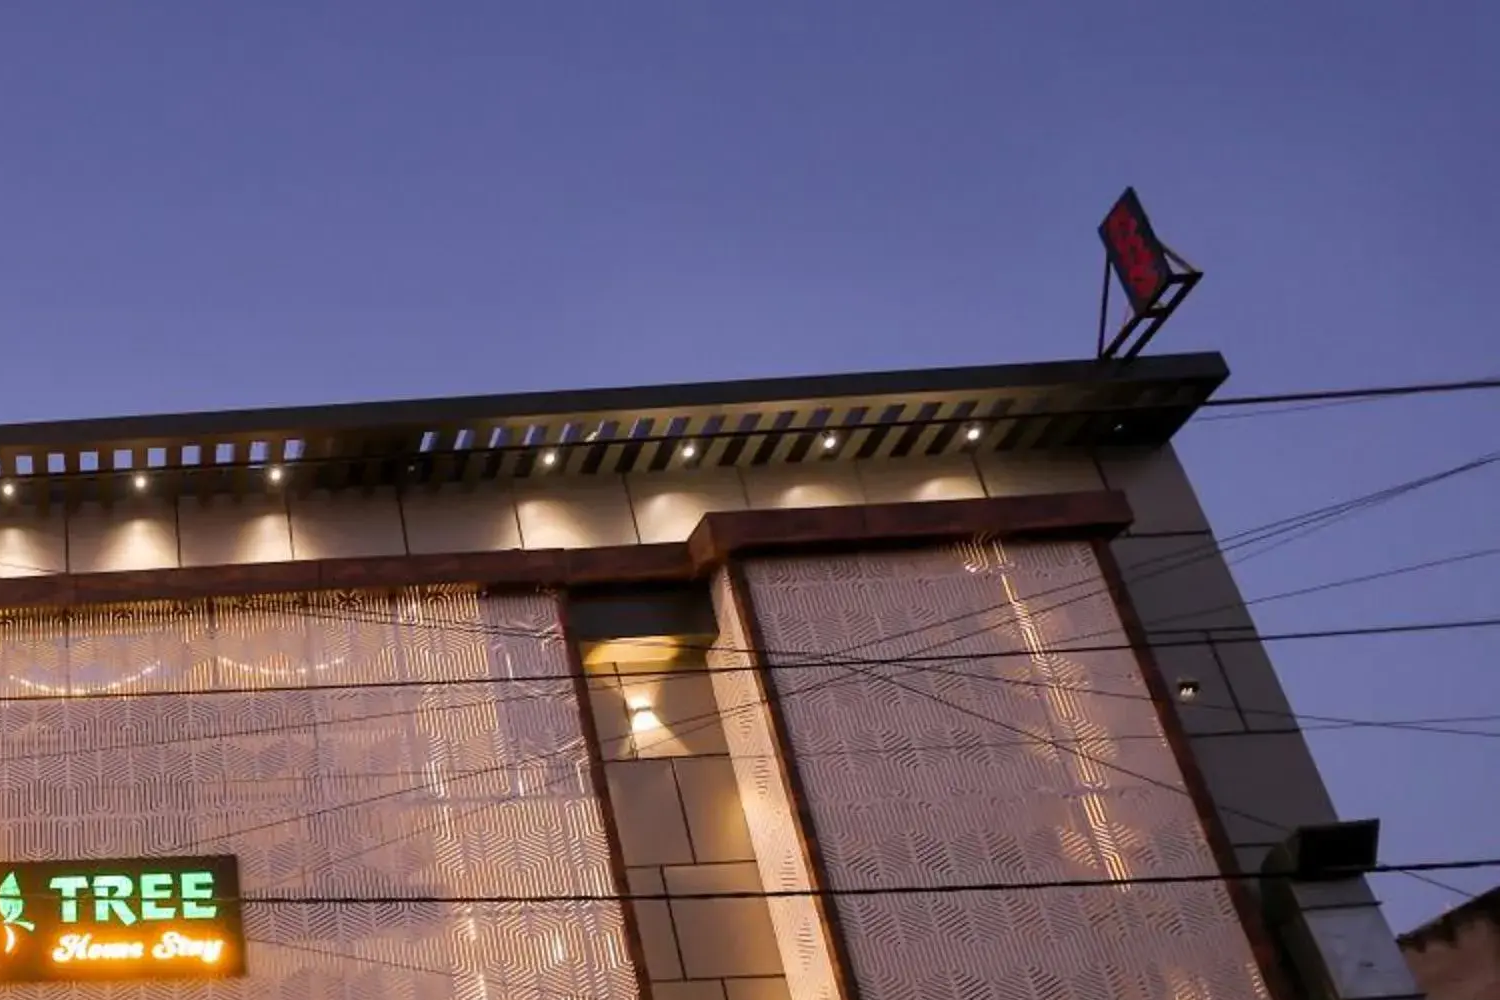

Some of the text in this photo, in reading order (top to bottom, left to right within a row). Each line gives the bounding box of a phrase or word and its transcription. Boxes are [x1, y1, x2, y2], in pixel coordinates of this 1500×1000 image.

[50, 872, 217, 926] TREE
[53, 931, 223, 964] Home Stay
